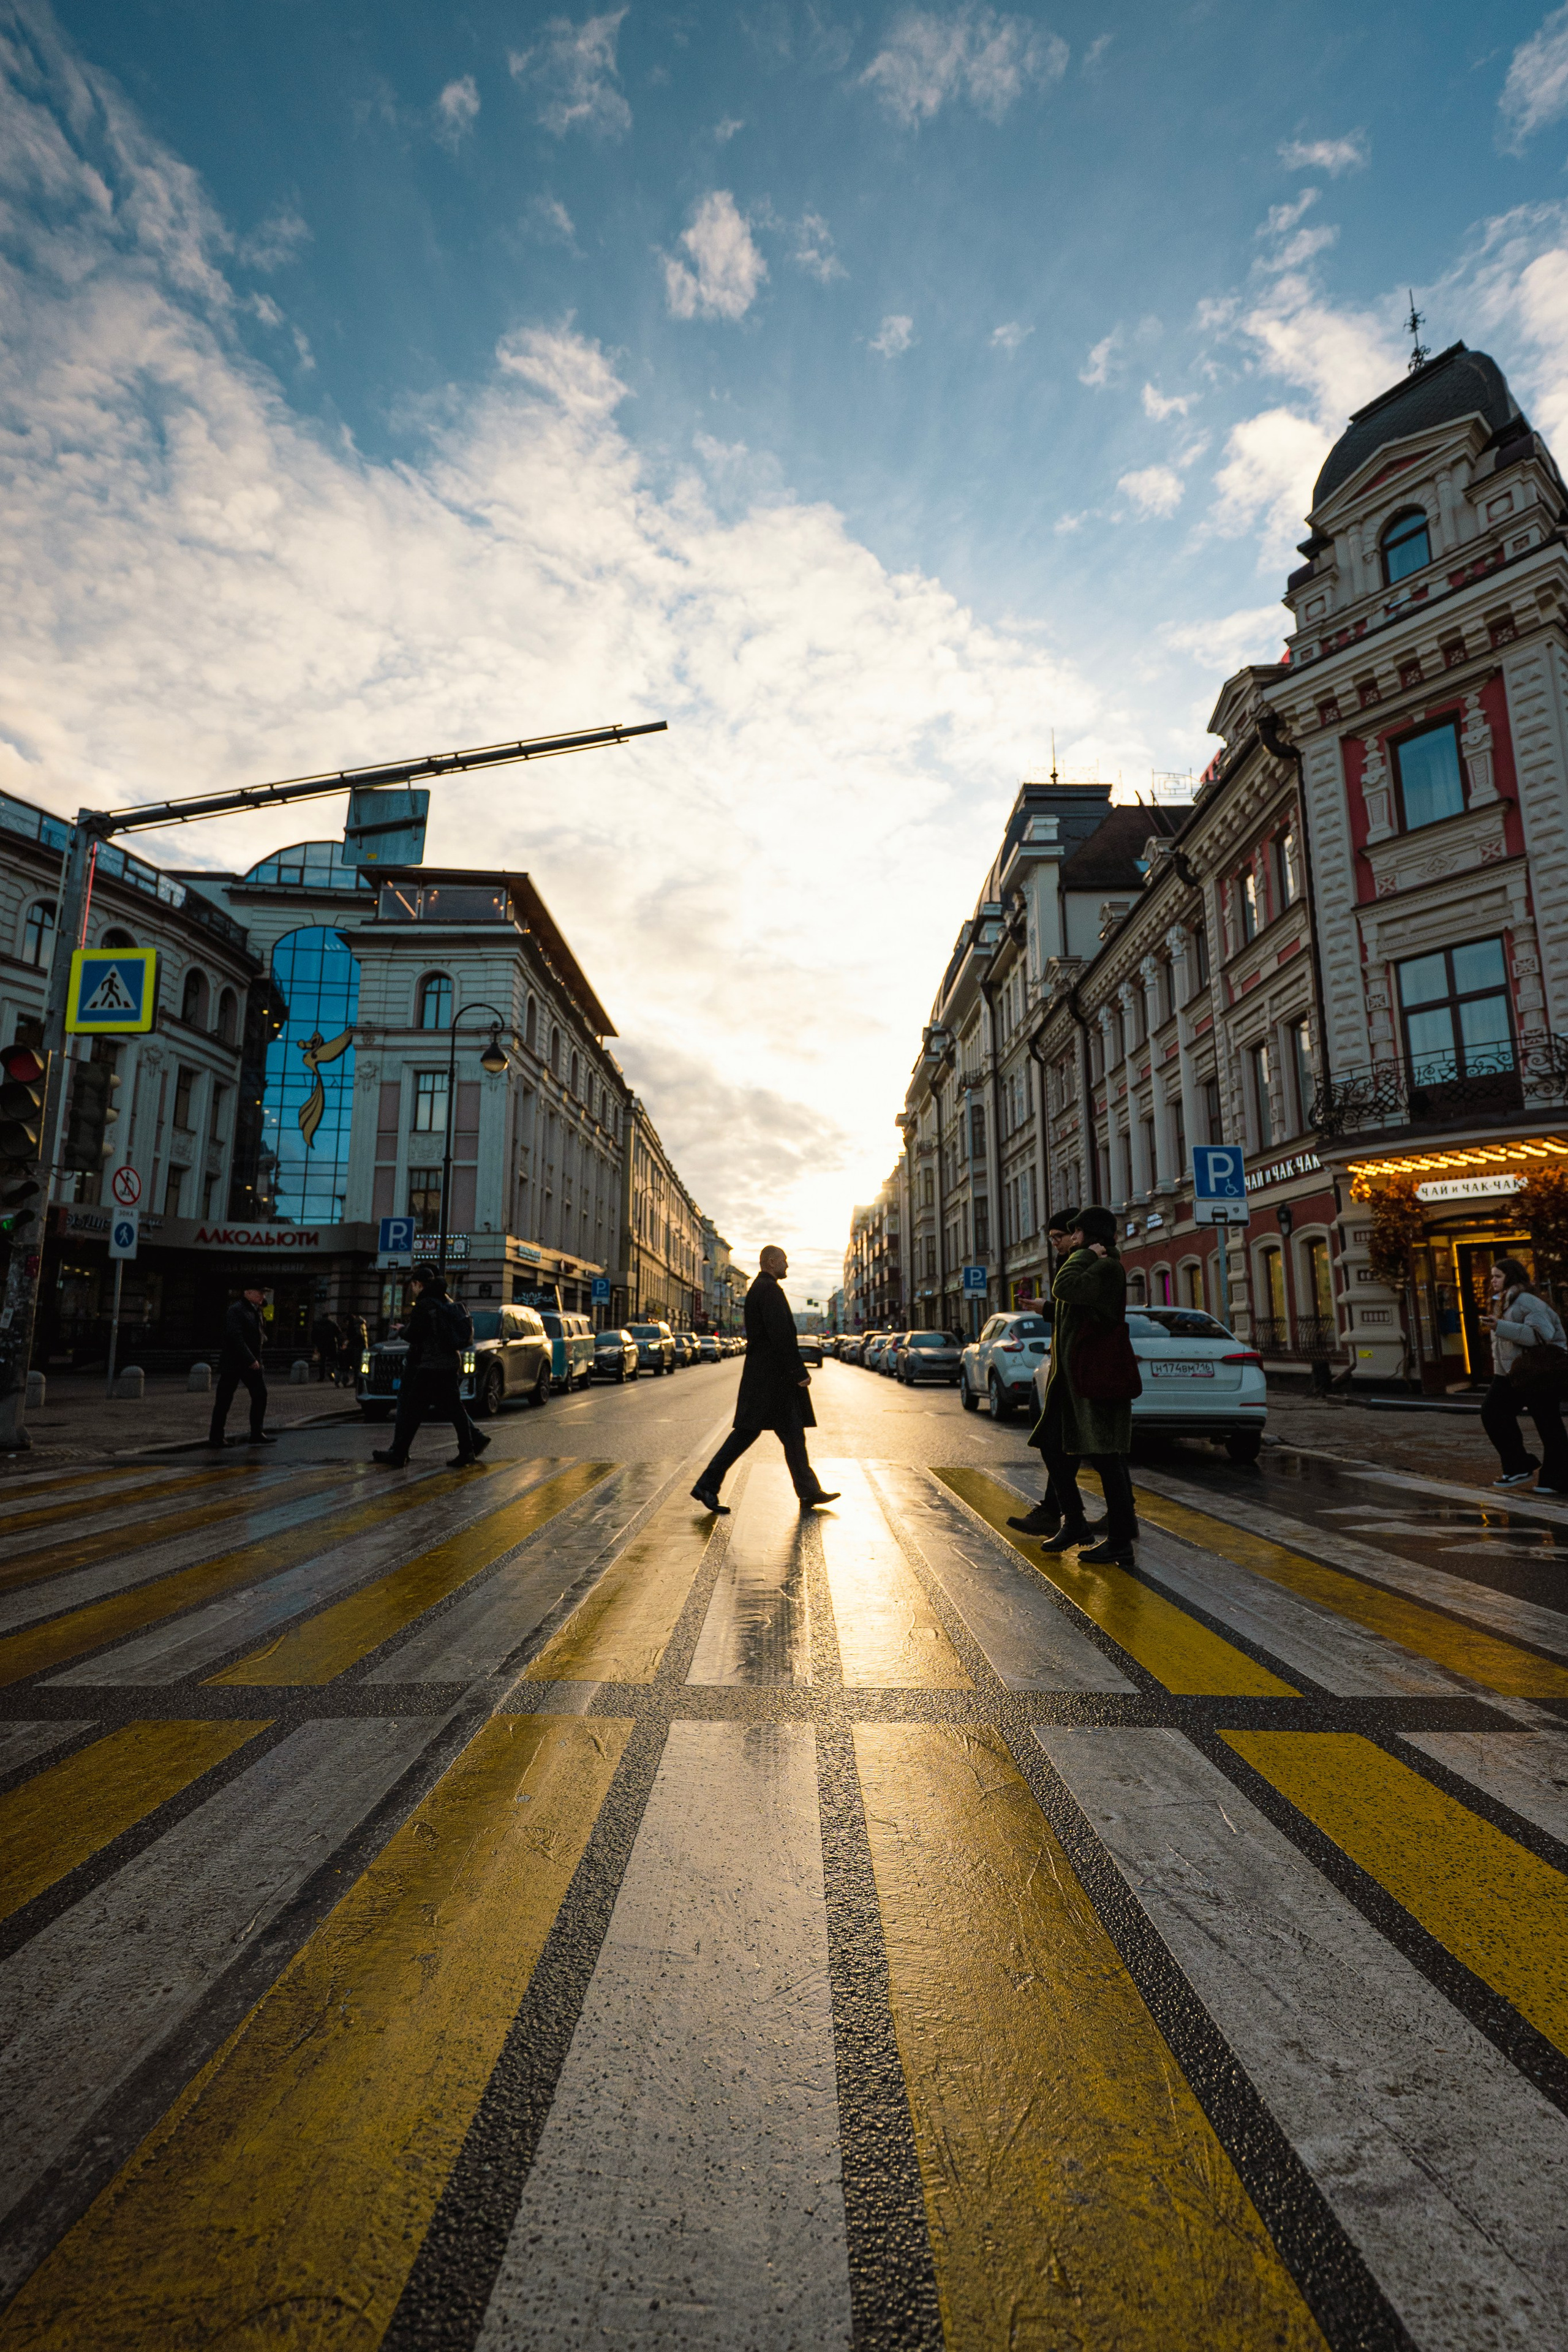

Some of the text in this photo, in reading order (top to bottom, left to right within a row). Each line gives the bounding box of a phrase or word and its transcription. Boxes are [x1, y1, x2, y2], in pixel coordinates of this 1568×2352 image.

[1207, 1152, 1234, 1193] P
[1245, 1168, 1264, 1191] ЧАЙ
[1422, 1183, 1448, 1196] ЧАЙ
[194, 1226, 319, 1247] АЛКОДЬЮТИ
[388, 1221, 407, 1249] P
[597, 1280, 606, 1295] P
[970, 1268, 982, 1287] P
